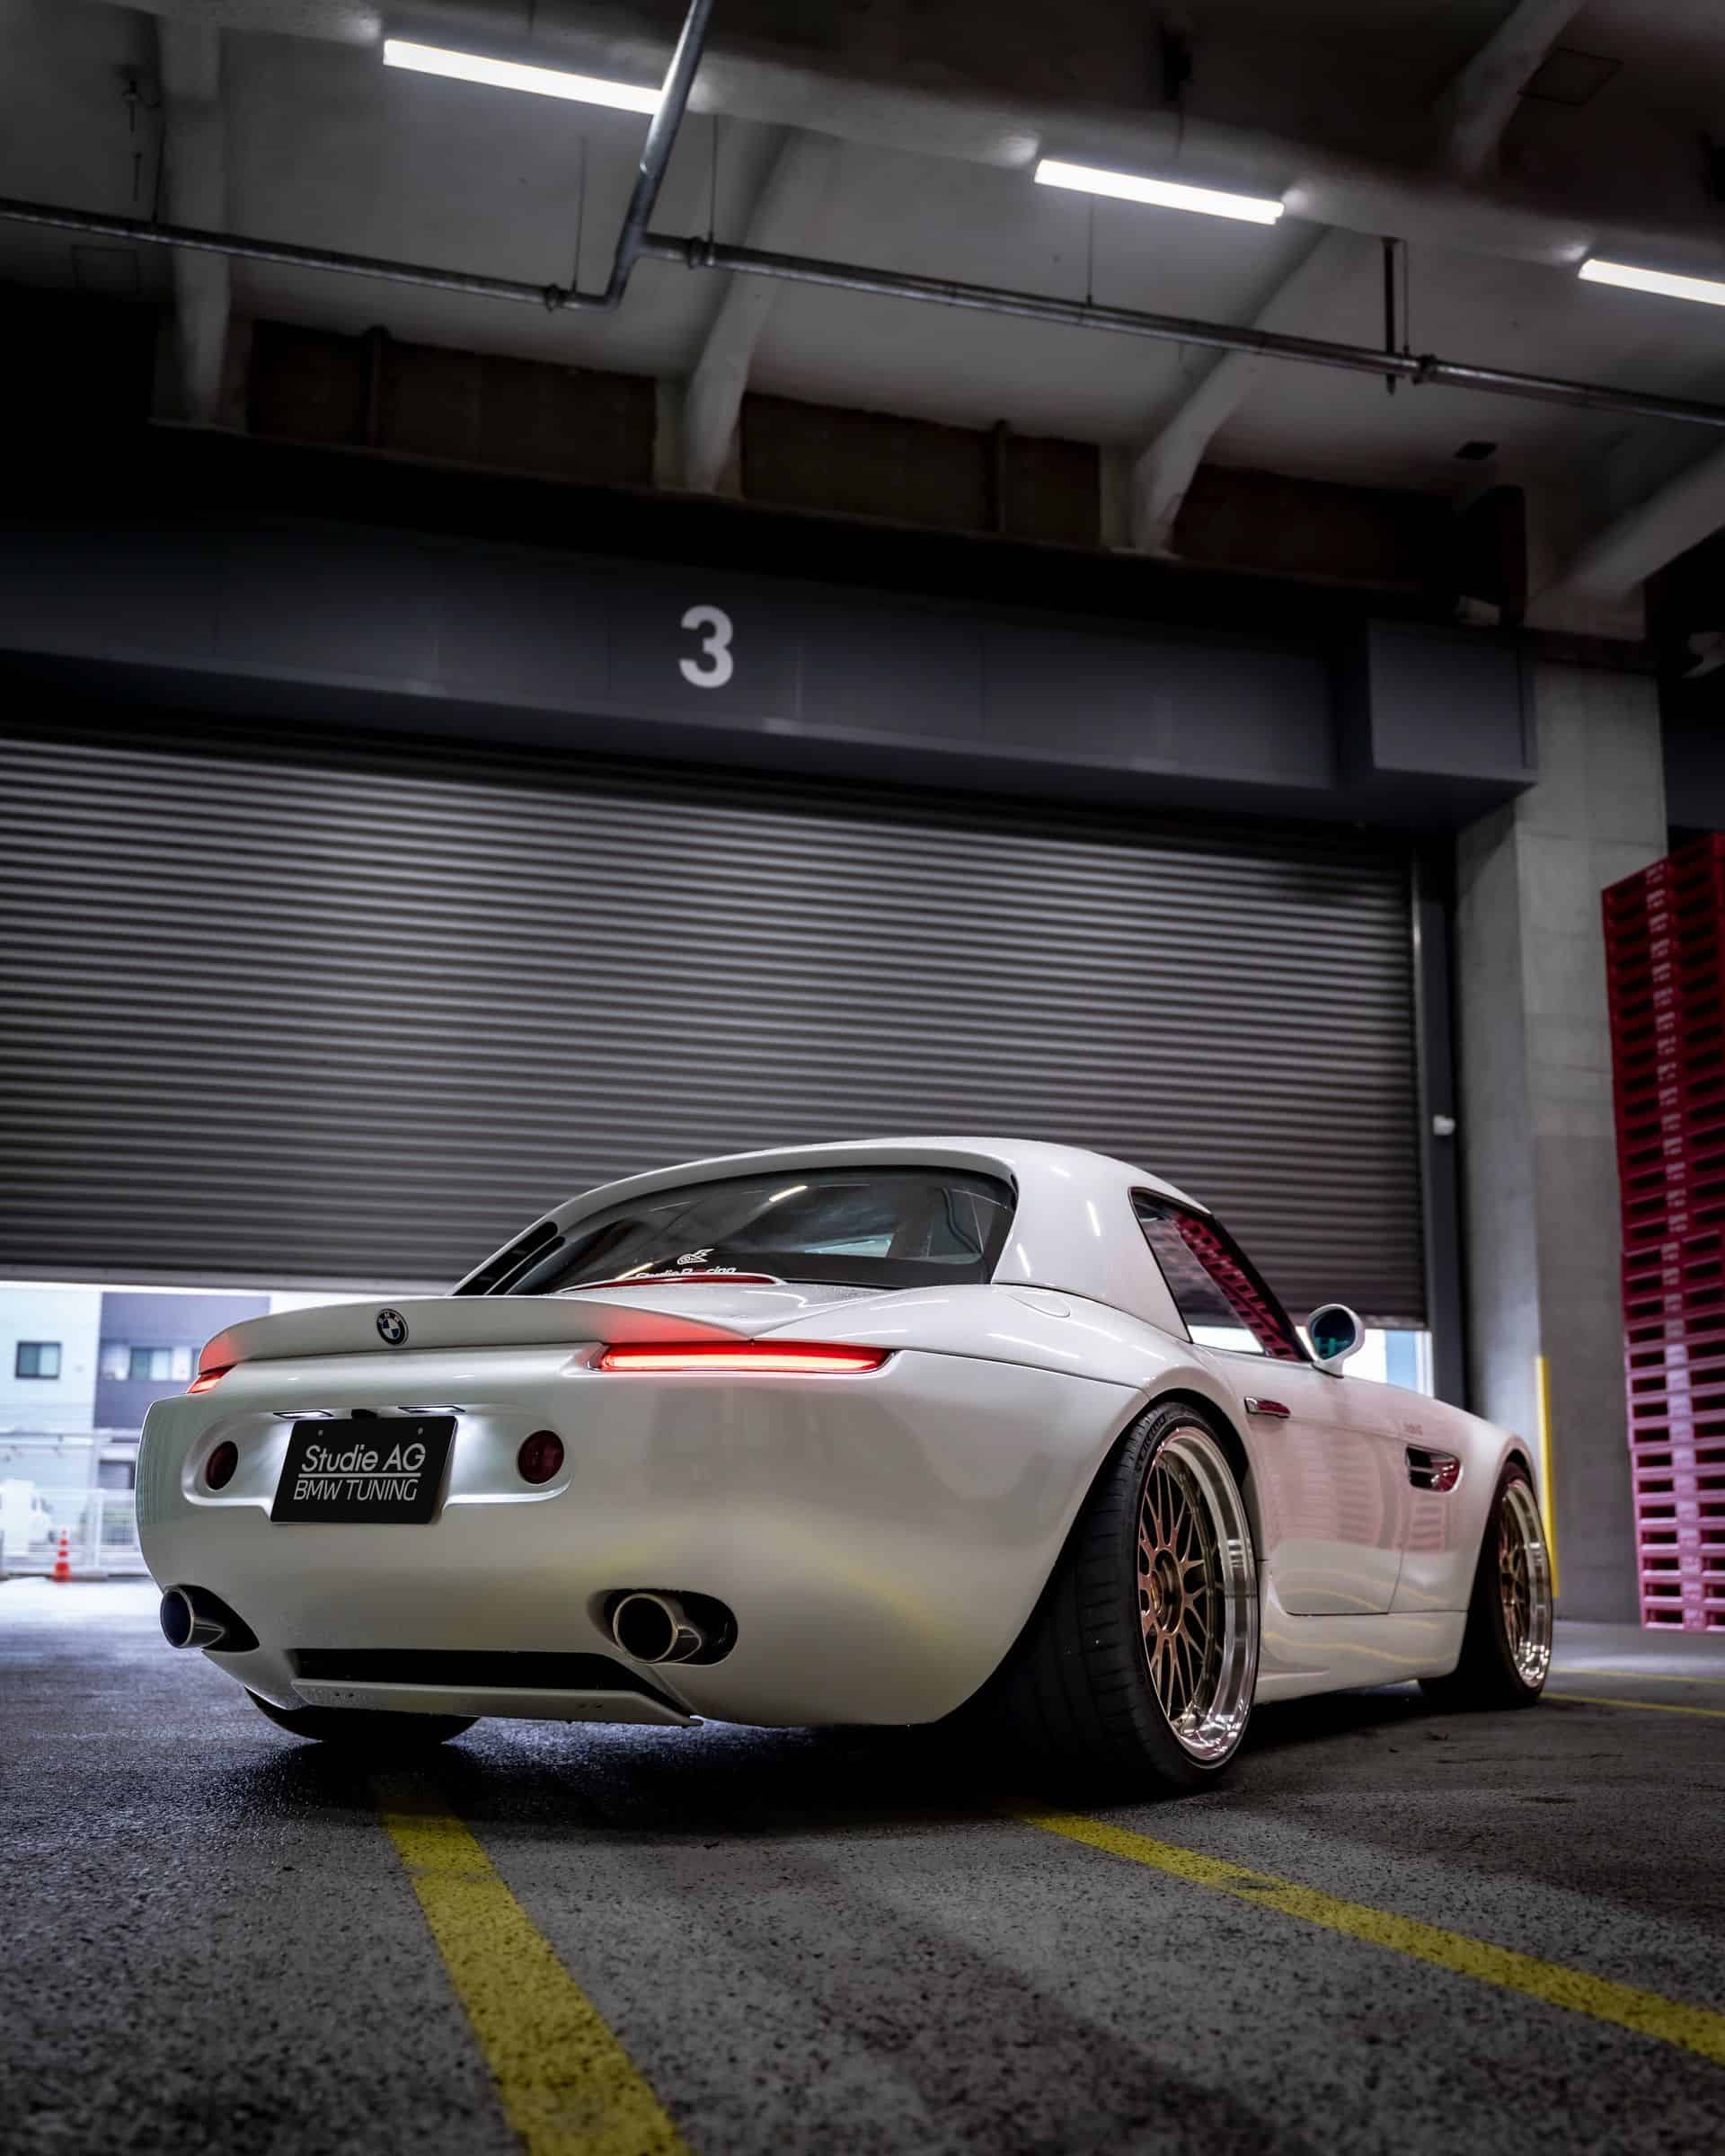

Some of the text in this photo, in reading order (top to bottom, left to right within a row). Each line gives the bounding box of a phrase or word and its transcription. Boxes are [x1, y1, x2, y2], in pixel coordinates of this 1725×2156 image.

[679, 605, 733, 689] 3
[301, 1443, 426, 1471] Studie AG
[293, 1479, 419, 1501] BMW TUNING
